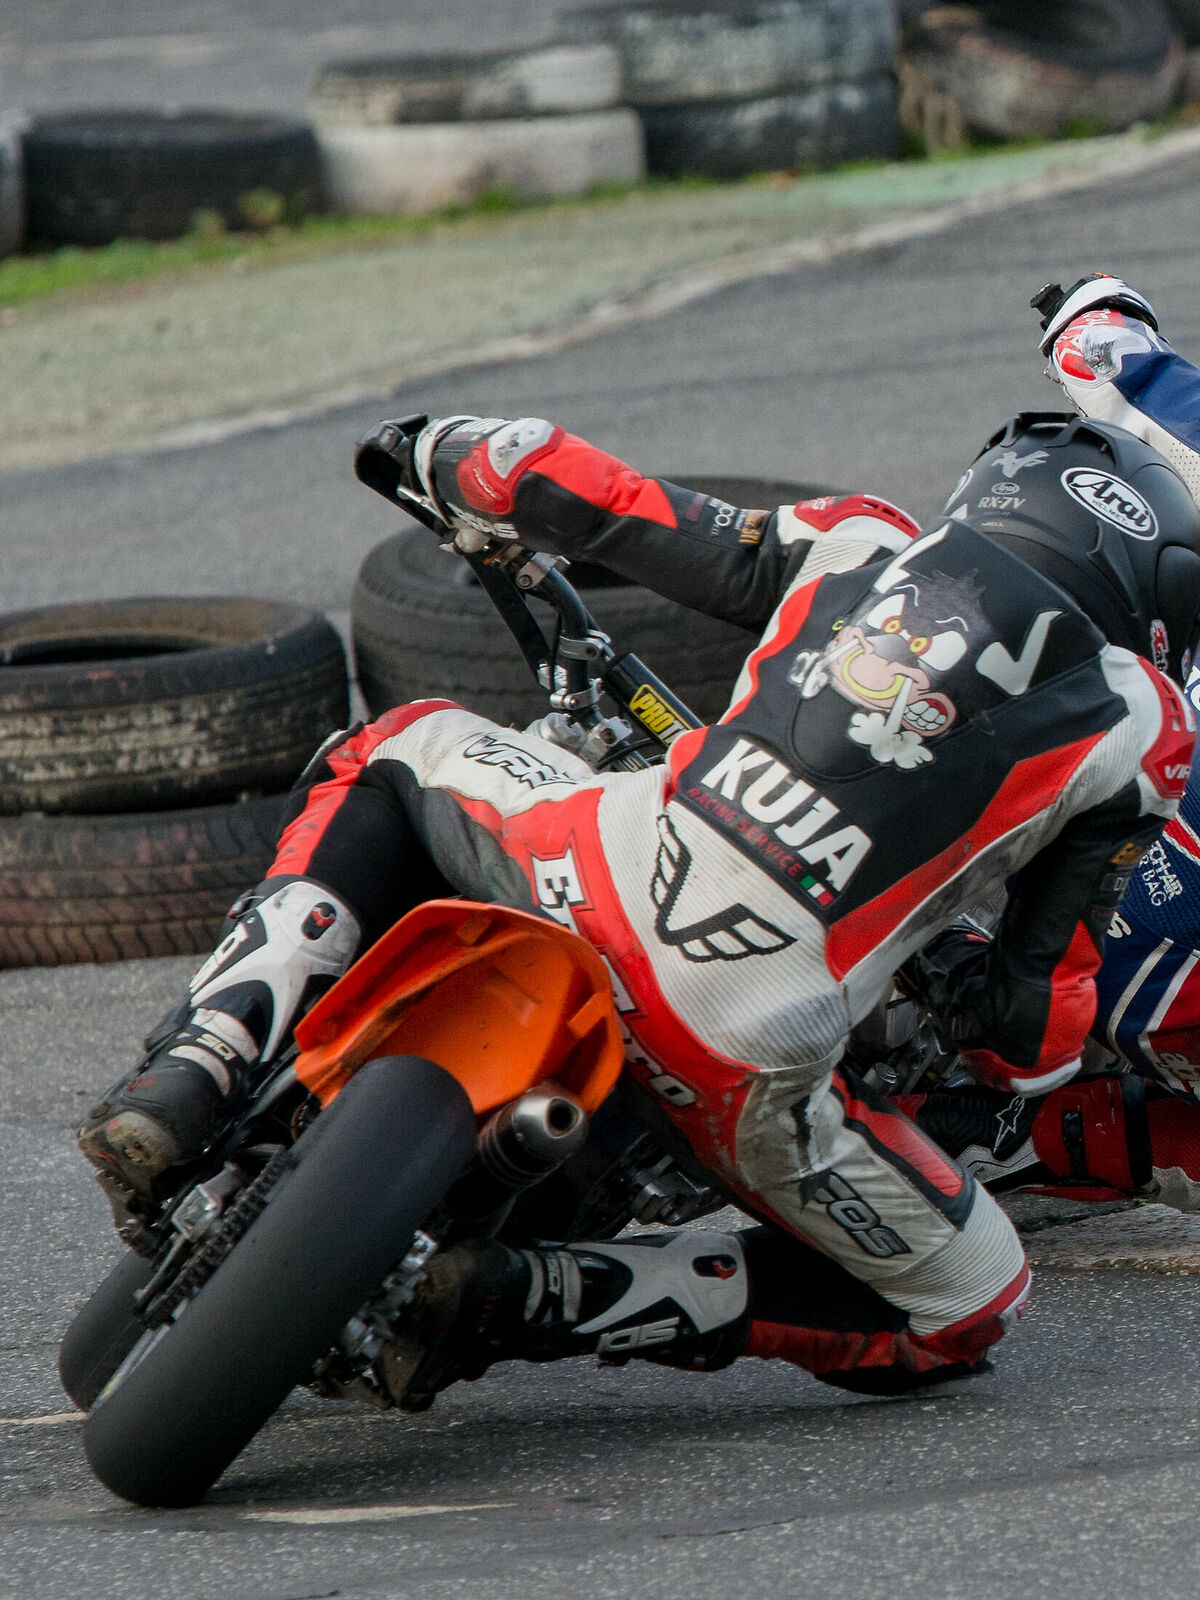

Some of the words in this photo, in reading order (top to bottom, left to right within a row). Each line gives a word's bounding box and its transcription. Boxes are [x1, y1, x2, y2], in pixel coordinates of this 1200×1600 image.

[977, 497, 1027, 508] RX-7V
[1068, 480, 1149, 527] Arai
[686, 786, 737, 823] RACING
[736, 819, 805, 876] SERVICE
[700, 737, 873, 892] KUJA
[1141, 869, 1168, 907] BAG
